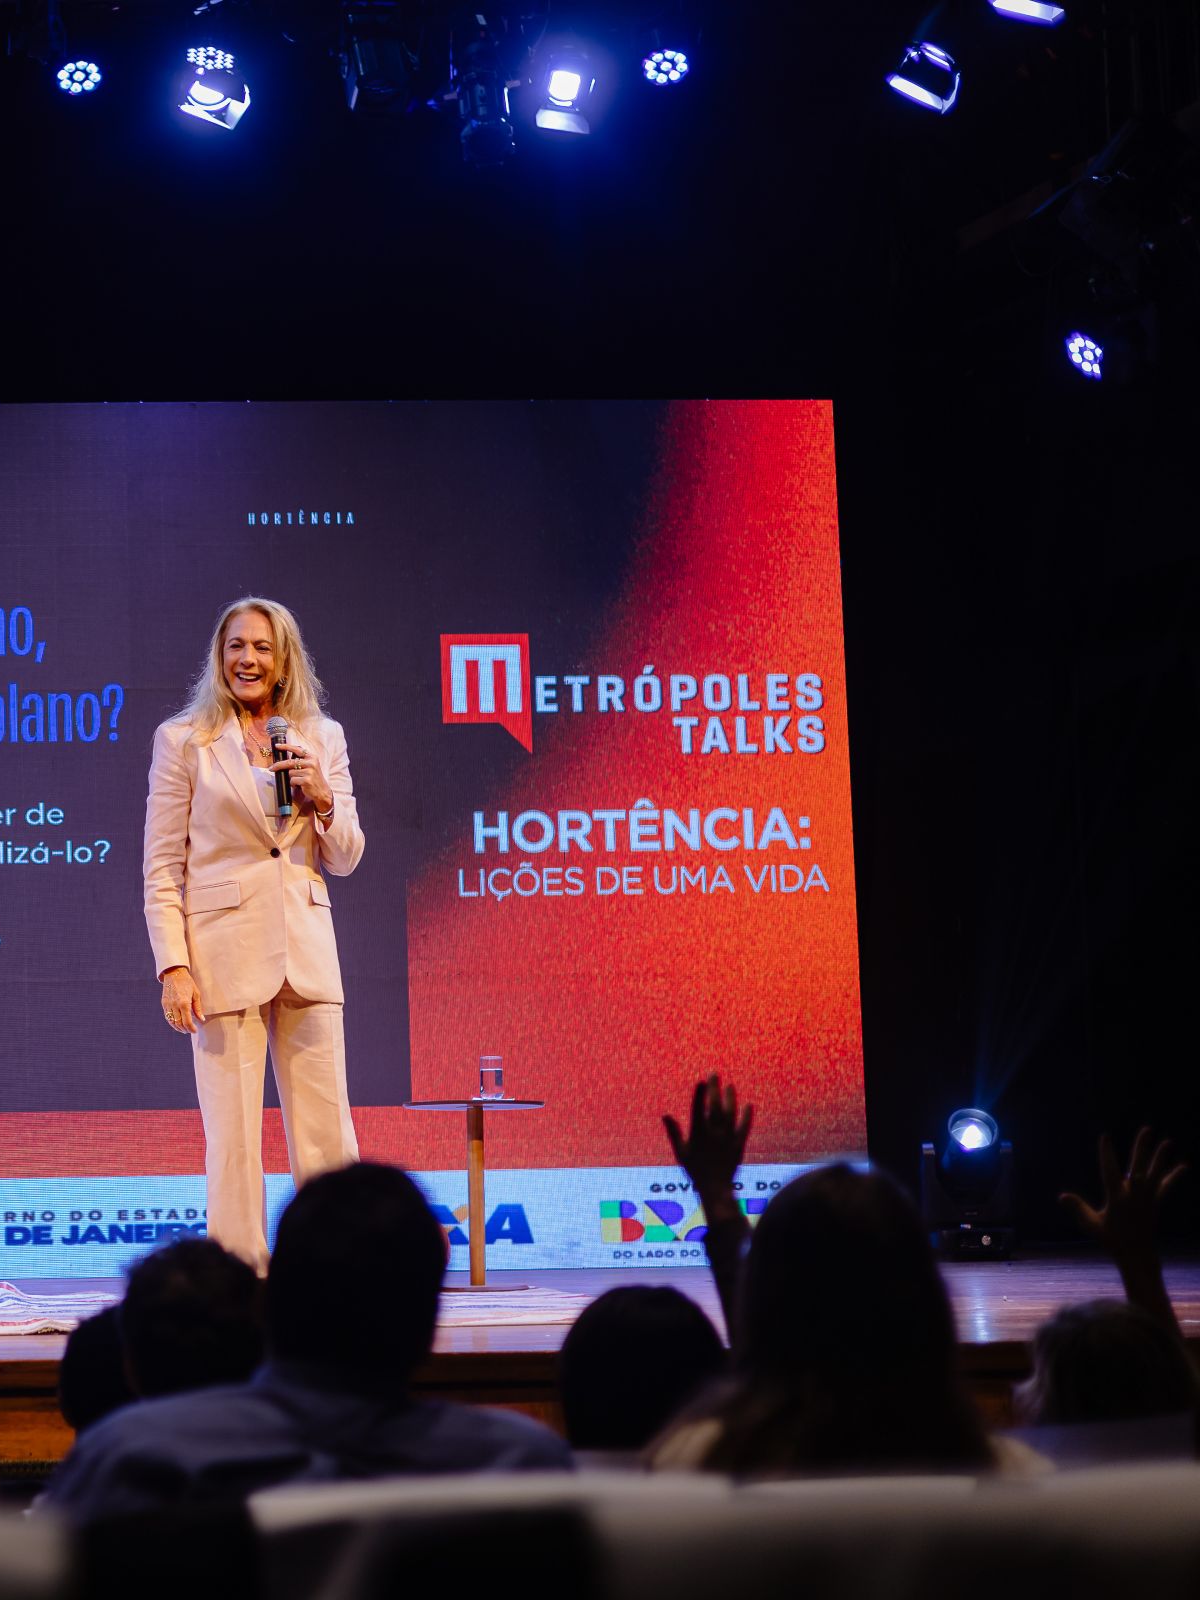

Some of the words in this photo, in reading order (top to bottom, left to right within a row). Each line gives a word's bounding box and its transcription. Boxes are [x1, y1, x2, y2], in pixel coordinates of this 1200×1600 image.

[247, 508, 355, 525] HORTÊNCIA
[449, 643, 824, 713] METRÓPOLES
[672, 716, 826, 755] TALKS
[25, 802, 65, 826] de
[473, 797, 811, 853] HORTÊNCIA:
[458, 862, 585, 901] LIÇÕES
[596, 866, 643, 895] DE
[654, 864, 735, 894] UMA
[744, 864, 830, 893] VIDA
[649, 1183, 744, 1193] GOVO
[69, 1210, 103, 1222] DO
[117, 1208, 208, 1221] ESTAD
[4, 1225, 54, 1246] DE
[613, 1250, 634, 1259] DO
[637, 1249, 676, 1258] LADO
[680, 1249, 701, 1257] DO
